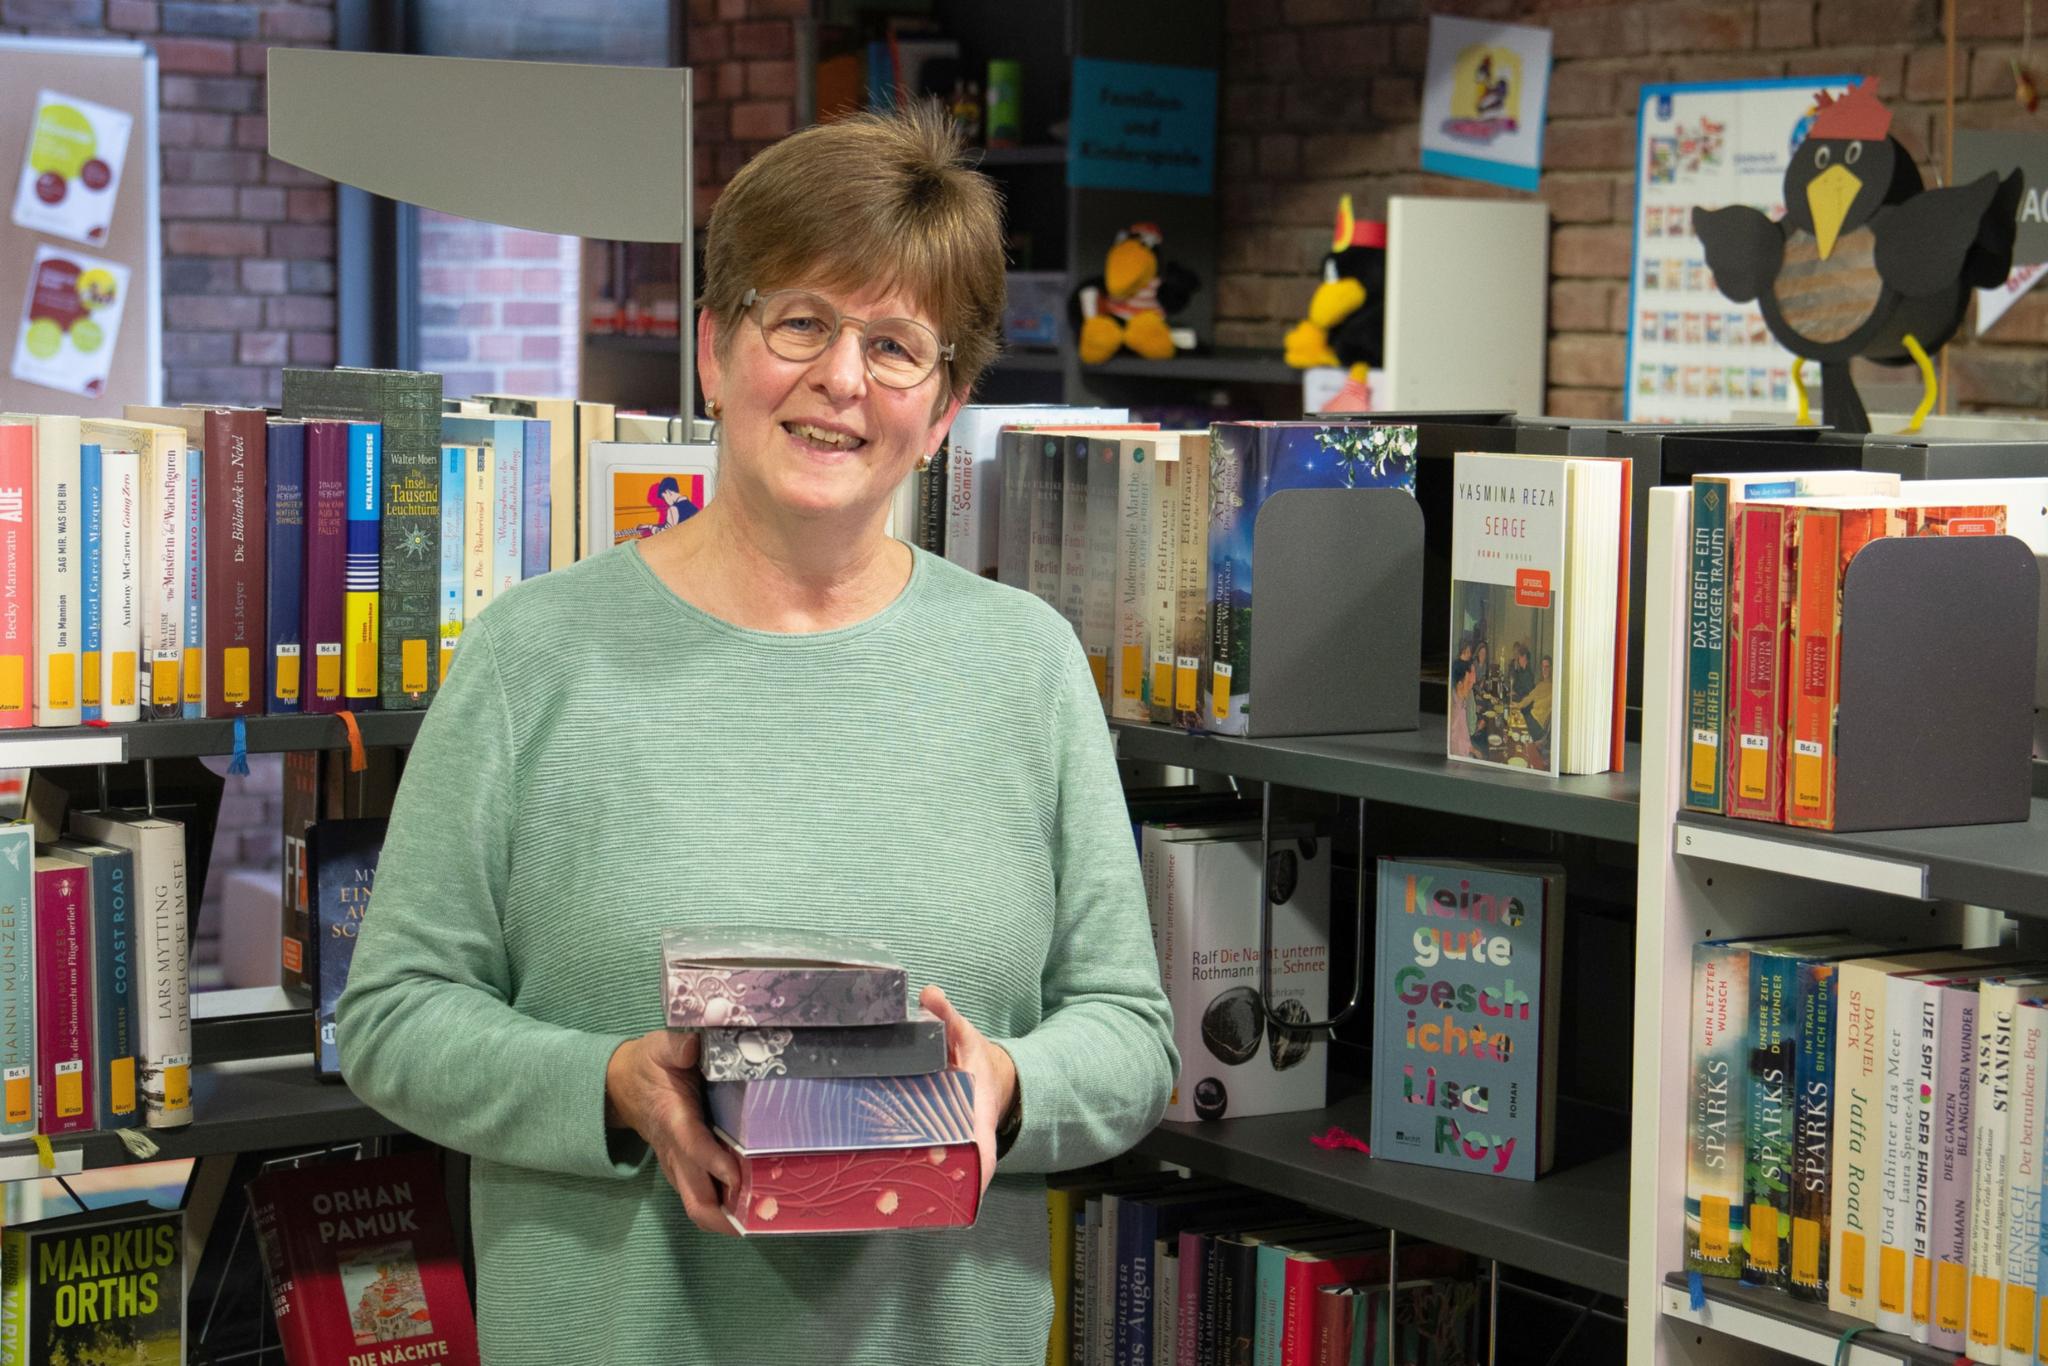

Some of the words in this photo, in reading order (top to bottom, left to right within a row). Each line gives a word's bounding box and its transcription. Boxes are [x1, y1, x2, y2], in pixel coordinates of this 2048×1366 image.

[232, 436, 245, 468] Nebel
[366, 432, 374, 511] KNALLKREBSE
[391, 453, 415, 465] Walter
[417, 455, 438, 465] Moers
[499, 460, 508, 471] der
[57, 484, 68, 498] BIN
[121, 474, 132, 496] Zero
[163, 450, 181, 521] Wachsfiguren
[235, 471, 245, 484] im
[391, 483, 438, 503] Tausend
[405, 477, 427, 489] Insel
[951, 445, 963, 517] träumten
[959, 448, 974, 511] Sommer
[1180, 455, 1193, 545] Eifelfrauen
[1459, 482, 1516, 505] YASMINA
[1522, 487, 1555, 508] REZA
[57, 500, 68, 514] ICH
[57, 516, 68, 534] WAS
[87, 486, 101, 543] Márquez
[122, 500, 134, 529] Going
[233, 486, 245, 542] Bibliothek
[498, 488, 508, 541] Wiedersehen
[1484, 515, 1527, 539] SERGE
[121, 532, 132, 581] McCarten
[162, 538, 177, 587] Meisterin
[235, 544, 245, 562] Die
[509, 528, 519, 557] kleinen
[1157, 499, 1169, 591] Eifelfrauen
[1694, 527, 1709, 555] EIN
[1709, 527, 1725, 583] TRAUM
[4, 530, 18, 598] Manawatu
[57, 556, 68, 573] SAG
[88, 549, 101, 592] García
[1188, 559, 1199, 598] RIEBE
[57, 594, 68, 630] Mannion
[122, 584, 134, 629] Anthony
[164, 587, 175, 603] Die
[1693, 571, 1708, 617] LEBEN
[4, 601, 19, 641] Becky
[57, 632, 68, 648] Una
[88, 598, 101, 648] Gabriel
[168, 623, 177, 647] MELLE
[1693, 621, 1707, 648] DAS
[1708, 586, 1723, 650] EWIGER
[1685, 835, 1693, 846] S
[111, 868, 126, 923] ROAD
[172, 859, 186, 890] SEE
[173, 895, 187, 915] IM
[1404, 873, 1525, 928] Keine
[0, 904, 17, 992] MÜNZER
[17, 897, 31, 982] Sehnsuchtsort
[155, 885, 170, 973] MYTTING
[1412, 926, 1513, 968] gute
[113, 930, 128, 995] COAST
[174, 920, 189, 999] GLOCKE
[1192, 950, 1218, 966] Ralf
[1220, 948, 1240, 964] Die
[1281, 944, 1326, 961] unterm
[1192, 965, 1254, 981] Rothmann
[1282, 959, 1326, 976] Schnee
[19, 985, 31, 1008] ein
[157, 978, 172, 1021] LARS
[1394, 965, 1529, 1021] Gesch
[1704, 961, 1717, 1007] LETZTER
[1717, 980, 1729, 1032] WUNSCH
[1759, 974, 1771, 1002] ZEIT
[1771, 974, 1784, 1028] WUNDER
[1817, 979, 1829, 1001] DIR
[3, 998, 18, 1065] HANNI
[175, 1004, 189, 1033] DIE
[1704, 1012, 1714, 1047] MEIN
[1758, 1004, 1770, 1050] UNSERE
[1804, 993, 1816, 1042] TRAUM
[1816, 1003, 1828, 1023] BEI
[1846, 989, 1861, 1049] SPECK
[1921, 1001, 1935, 1040] LIZE
[1960, 1007, 1974, 1063] WUNDER
[1405, 1009, 1515, 1063] ichte
[1771, 1031, 1782, 1054] DER
[1803, 1044, 1814, 1055] IM
[1815, 1026, 1828, 1048] ICH
[1861, 1006, 1876, 1078] DANIEL
[1887, 1028, 1901, 1078] Meer
[2021, 1028, 2041, 1060] Berg
[1815, 1051, 1827, 1072] BIN
[1920, 1044, 1933, 1081] SPIT
[1402, 1064, 1489, 1114] Lisa
[1509, 1082, 1518, 1119] ROMAN
[1697, 1072, 1708, 1151] NICHOLAS
[1885, 1084, 1900, 1115] das
[1957, 1066, 1972, 1157] BELANGLOSEN
[2019, 1064, 2035, 1147] betrunkene
[1705, 1060, 1730, 1170] SPARKS
[1760, 1067, 1786, 1180] SPARKS
[1804, 1081, 1829, 1193] SPARKS
[1848, 1087, 1868, 1154] Jaffa
[1900, 1077, 1915, 1160] Spence-Ash
[1918, 1110, 1930, 1144] DER
[1944, 1092, 1957, 1144] GANZEN
[1433, 1115, 1518, 1174] Roy
[1882, 1120, 1899, 1201] dahinter
[1943, 1146, 1955, 1182] DIESE
[2018, 1149, 2032, 1176] Der
[312, 1181, 414, 1216] ORHAN
[1846, 1163, 1865, 1231] Road
[1899, 1165, 1911, 1205] Laura
[1914, 1150, 1929, 1234] EHRLICHE
[318, 1208, 421, 1244] PAMUK
[1881, 1206, 1895, 1246] Und
[39, 1224, 175, 1285] MARKUS
[1074, 1223, 1087, 1281] SOMMER
[55, 1271, 160, 1328] ORTHS
[1074, 1287, 1085, 1337] LETZTE
[1119, 1263, 1129, 1345] SCHLESSER
[1128, 1256, 1151, 1333] Augen
[1, 1290, 19, 1351] MARY
[1287, 1285, 1297, 1355] AUFSTEHEN
[347, 1352, 378, 1366] DIE
[379, 1339, 450, 1366] NÄCHTE
[1074, 1344, 1085, 1361] 25
